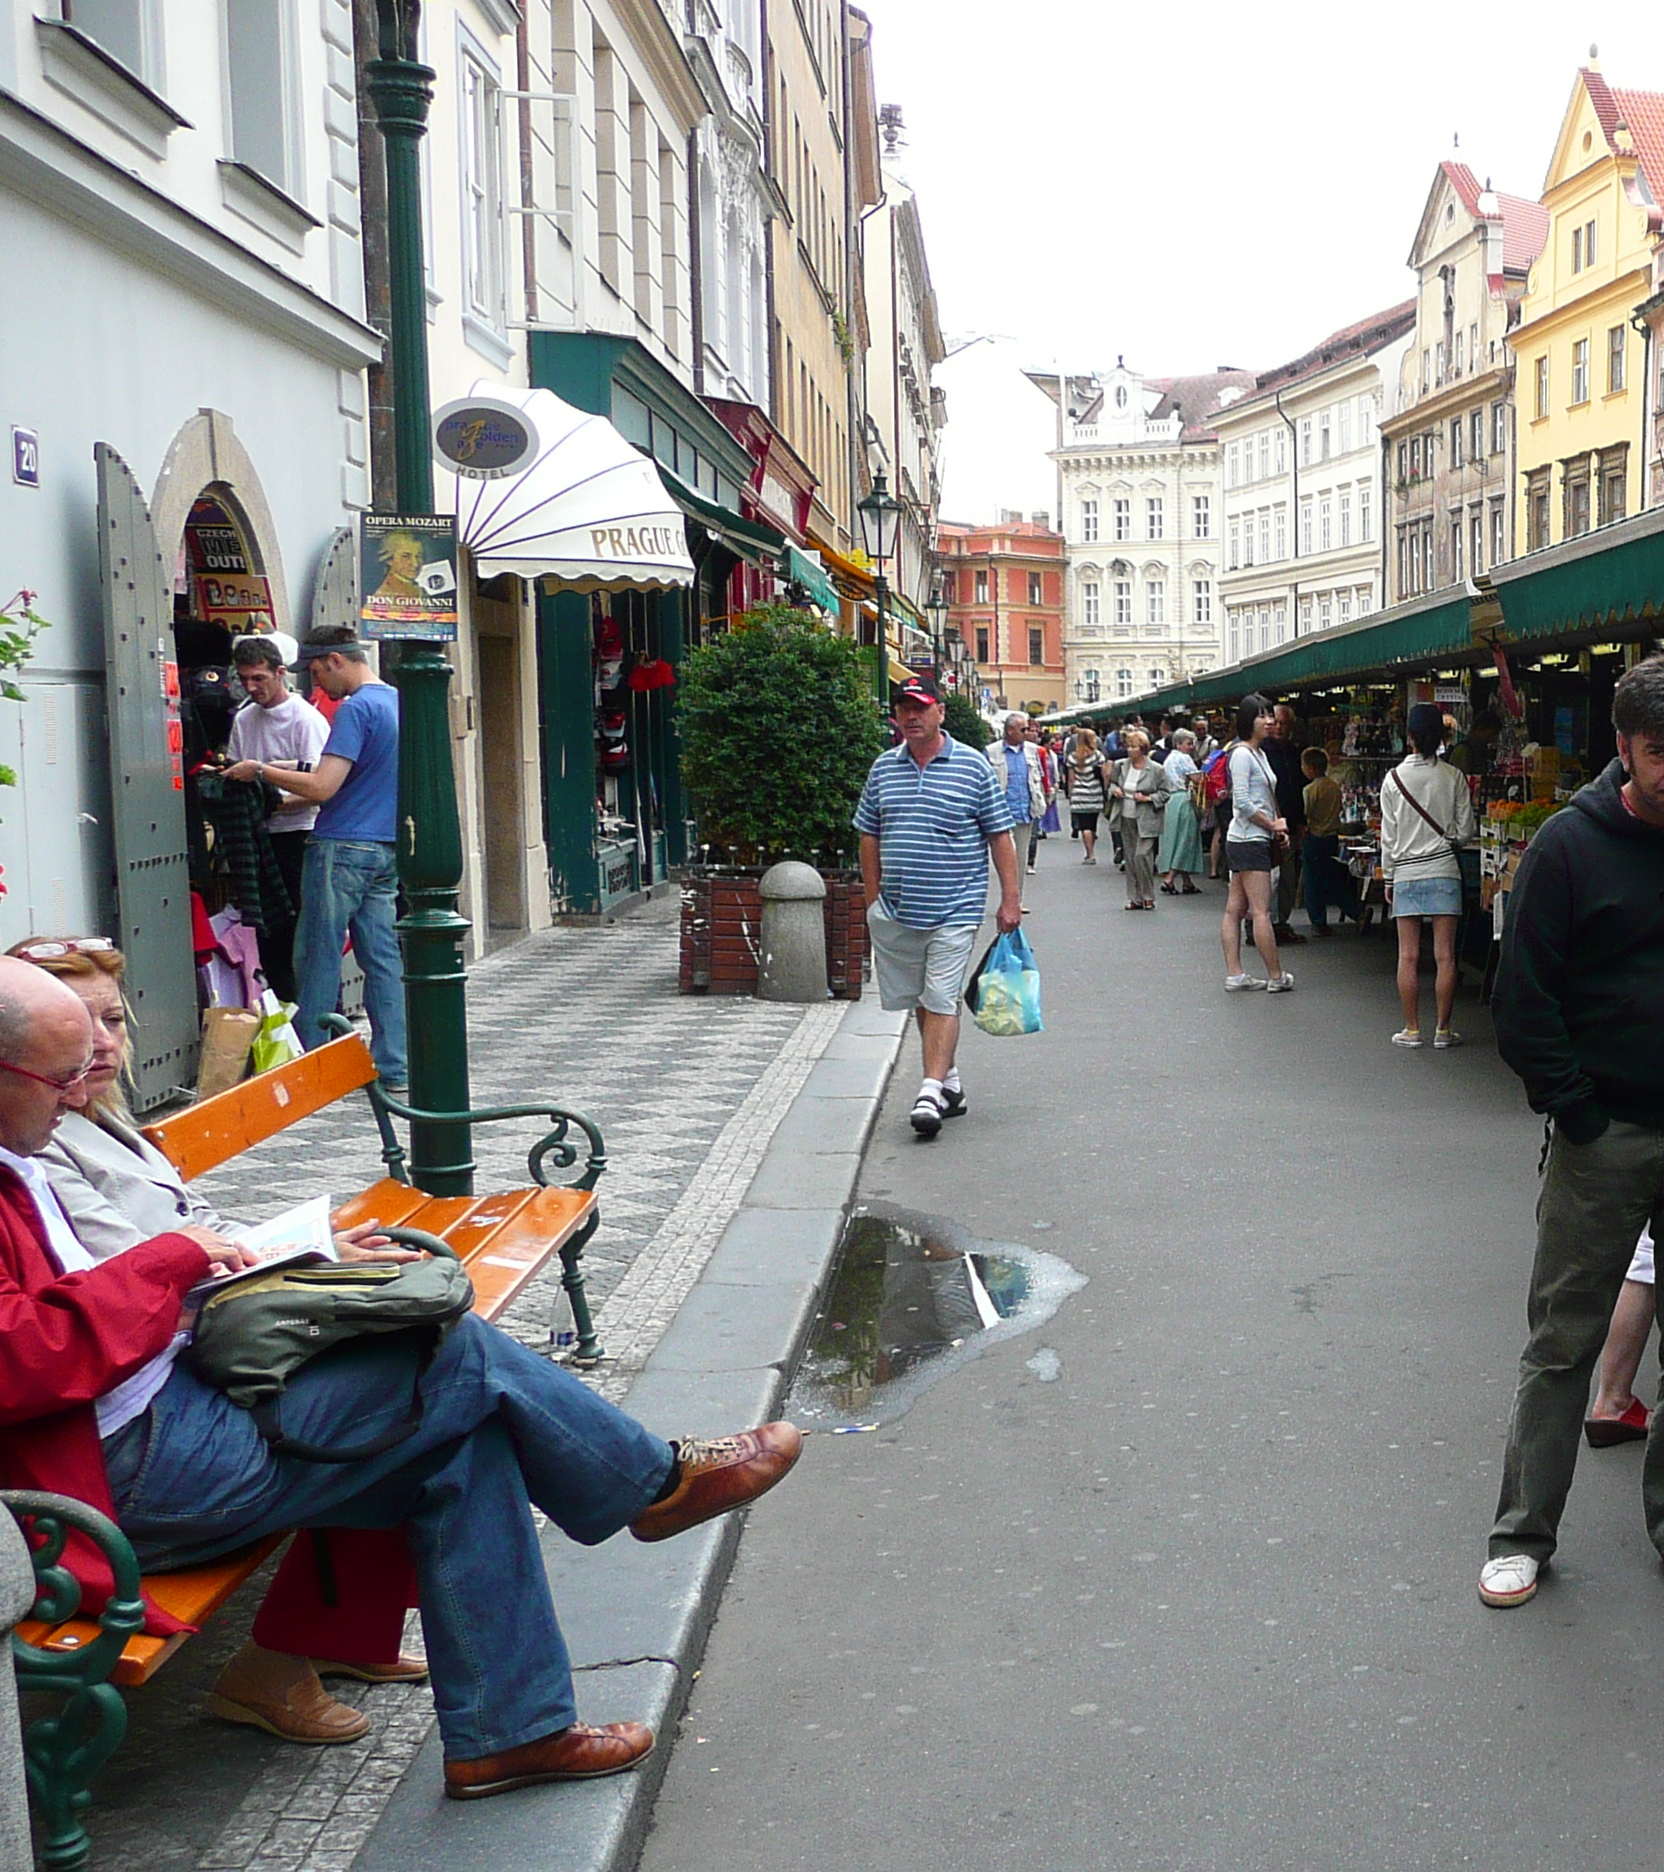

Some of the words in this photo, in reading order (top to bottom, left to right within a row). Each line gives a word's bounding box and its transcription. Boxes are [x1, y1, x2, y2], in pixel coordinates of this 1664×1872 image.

[21, 441, 37, 473] 20
[455, 465, 511, 480] HOTEL
[366, 516, 403, 526] OPERA
[405, 517, 453, 527] MOZART
[196, 529, 239, 538] CZECH
[201, 540, 242, 556] ME
[590, 527, 676, 558] PRAGUE
[206, 555, 247, 569] OUT!
[366, 596, 394, 605] DON
[396, 597, 453, 607] GIOVANNI
